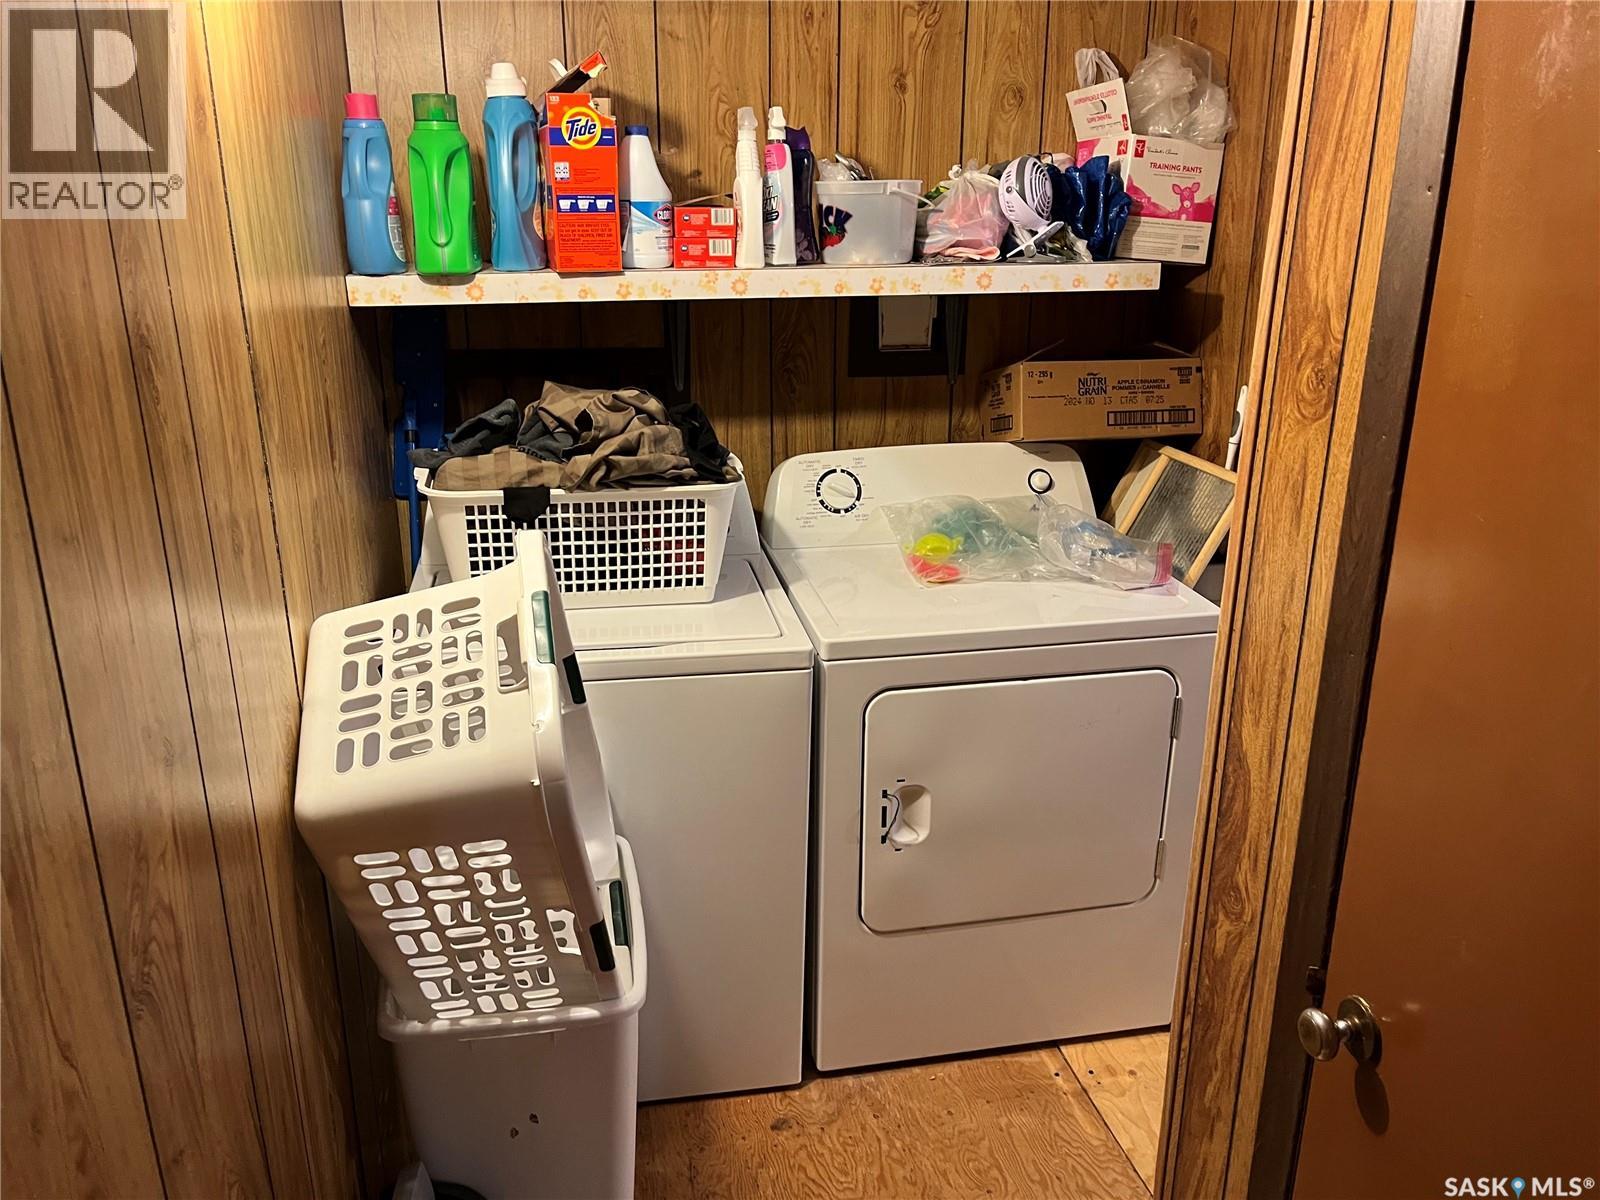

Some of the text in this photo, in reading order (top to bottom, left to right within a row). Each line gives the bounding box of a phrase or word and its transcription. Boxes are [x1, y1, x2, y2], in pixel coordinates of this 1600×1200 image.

[565, 118, 597, 142] Tide
[1149, 162, 1203, 174] TRAINING PANTS
[1078, 377, 1107, 388] NUTRI
[1078, 386, 1107, 397] GRAIN
[1063, 396, 1082, 406] 2024
